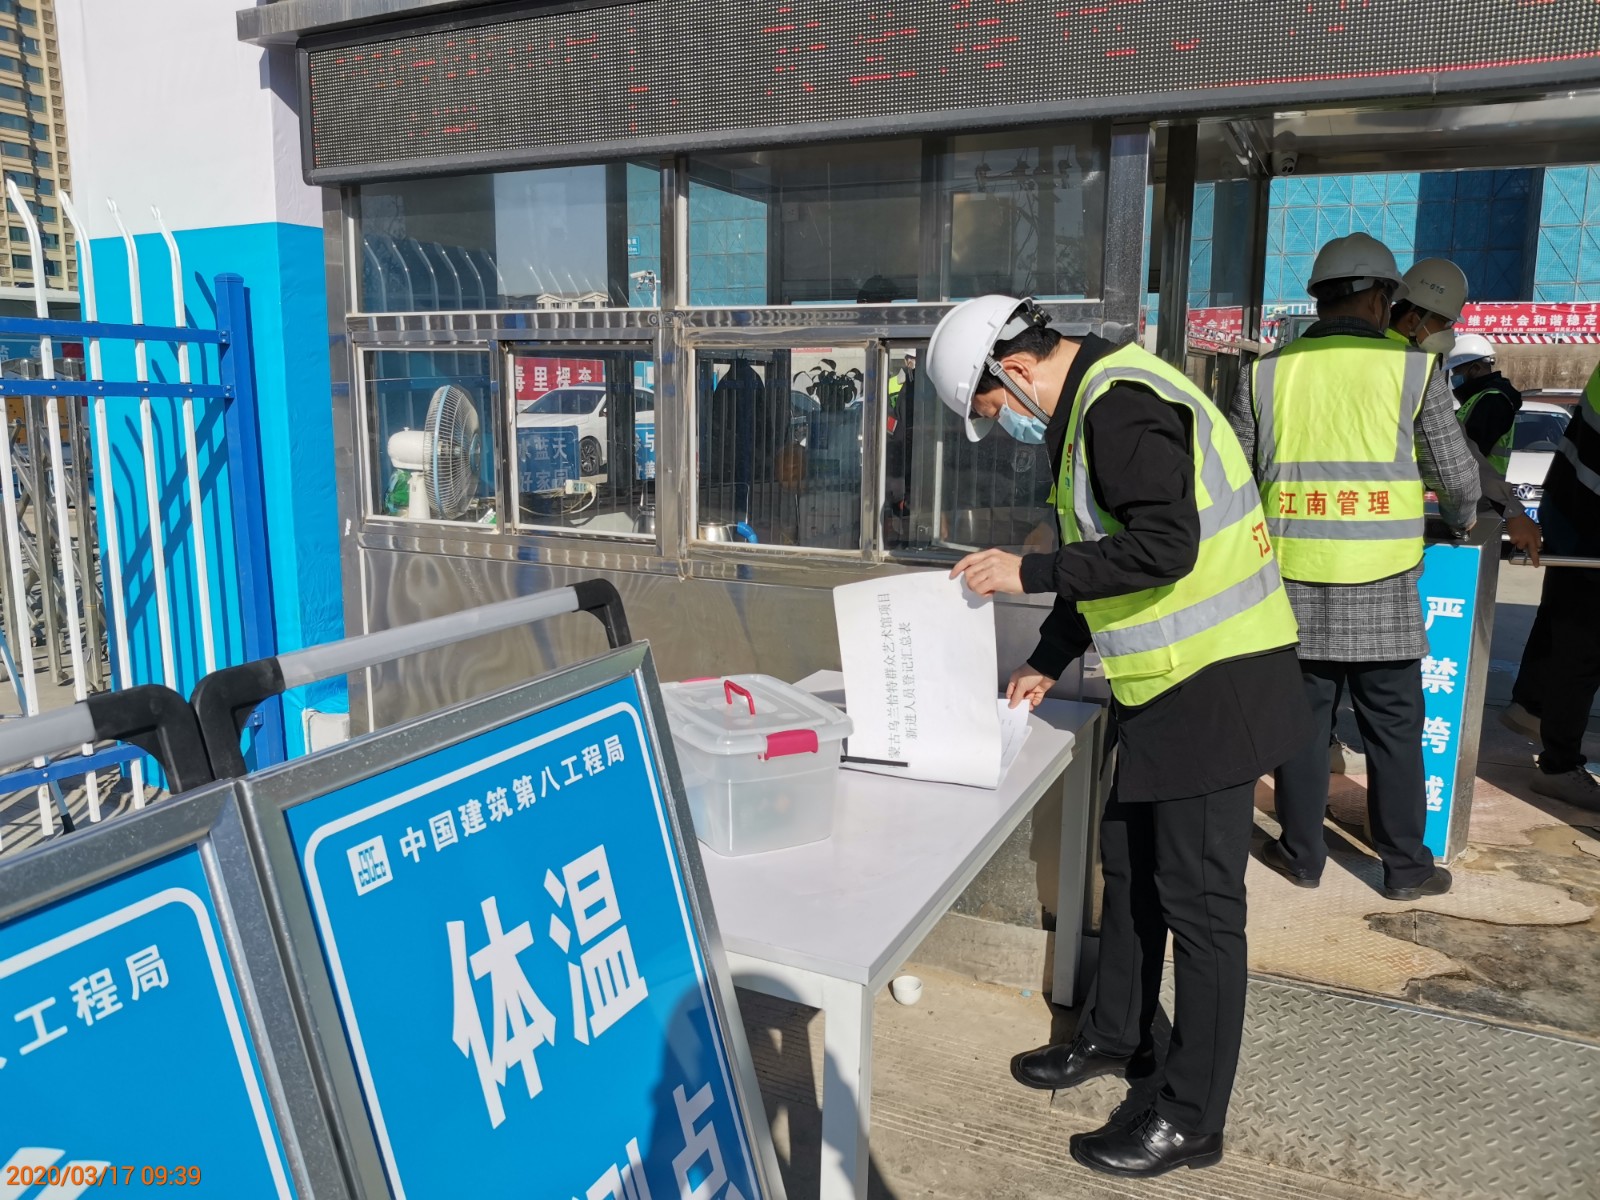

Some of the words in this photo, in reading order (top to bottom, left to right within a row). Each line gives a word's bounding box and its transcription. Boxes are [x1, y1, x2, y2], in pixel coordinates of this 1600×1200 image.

[1467, 314, 1598, 327] 维护社会和谐稳定
[1279, 490, 1391, 516] 江南管理
[898, 622, 918, 740] 新进人员登记汇总表
[399, 734, 625, 863] 中国建筑第八工程局
[0, 945, 170, 1069] 工程局
[446, 844, 649, 1130] 体温
